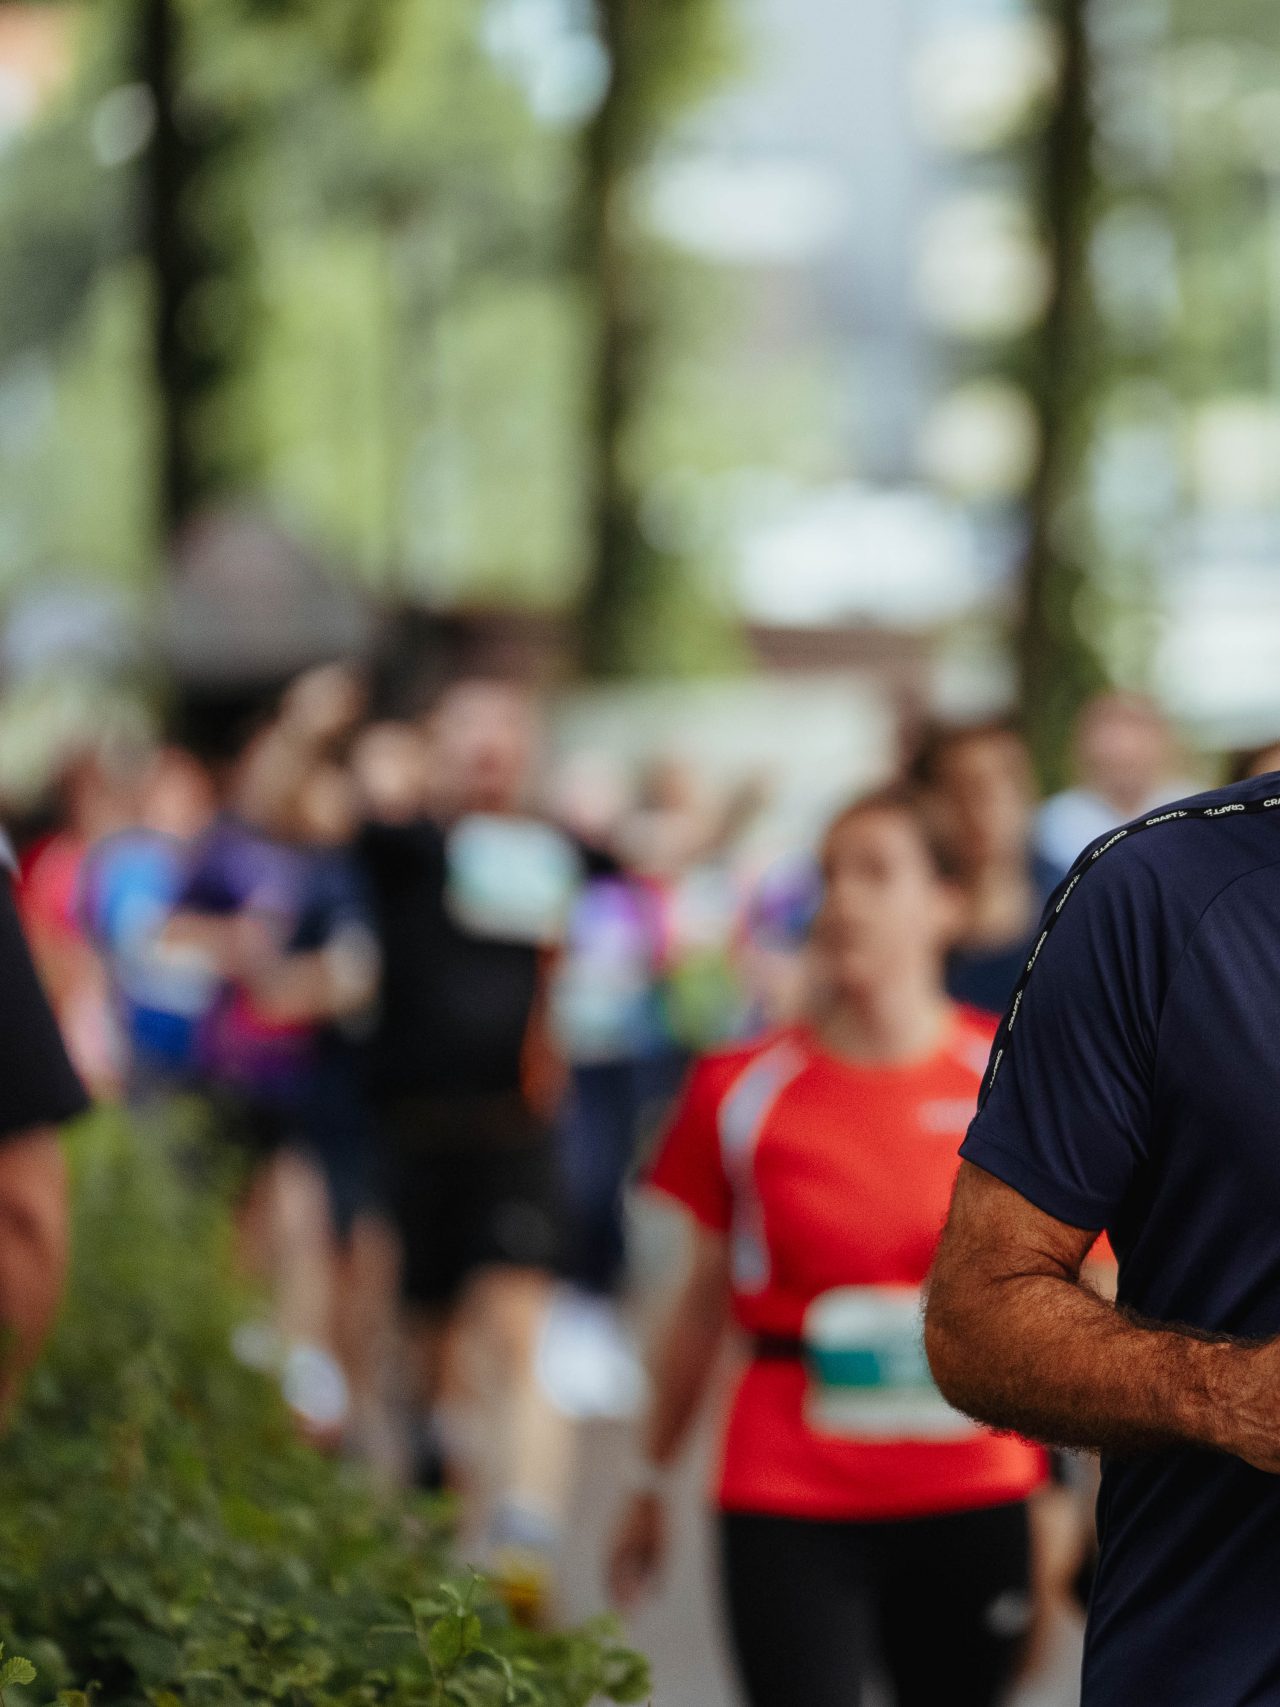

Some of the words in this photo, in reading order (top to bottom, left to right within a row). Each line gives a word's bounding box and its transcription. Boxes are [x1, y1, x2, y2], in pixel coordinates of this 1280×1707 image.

[1213, 803, 1245, 815] CRAFT
[1145, 811, 1177, 825] CRAFT
[1099, 830, 1128, 853] CRAFT
